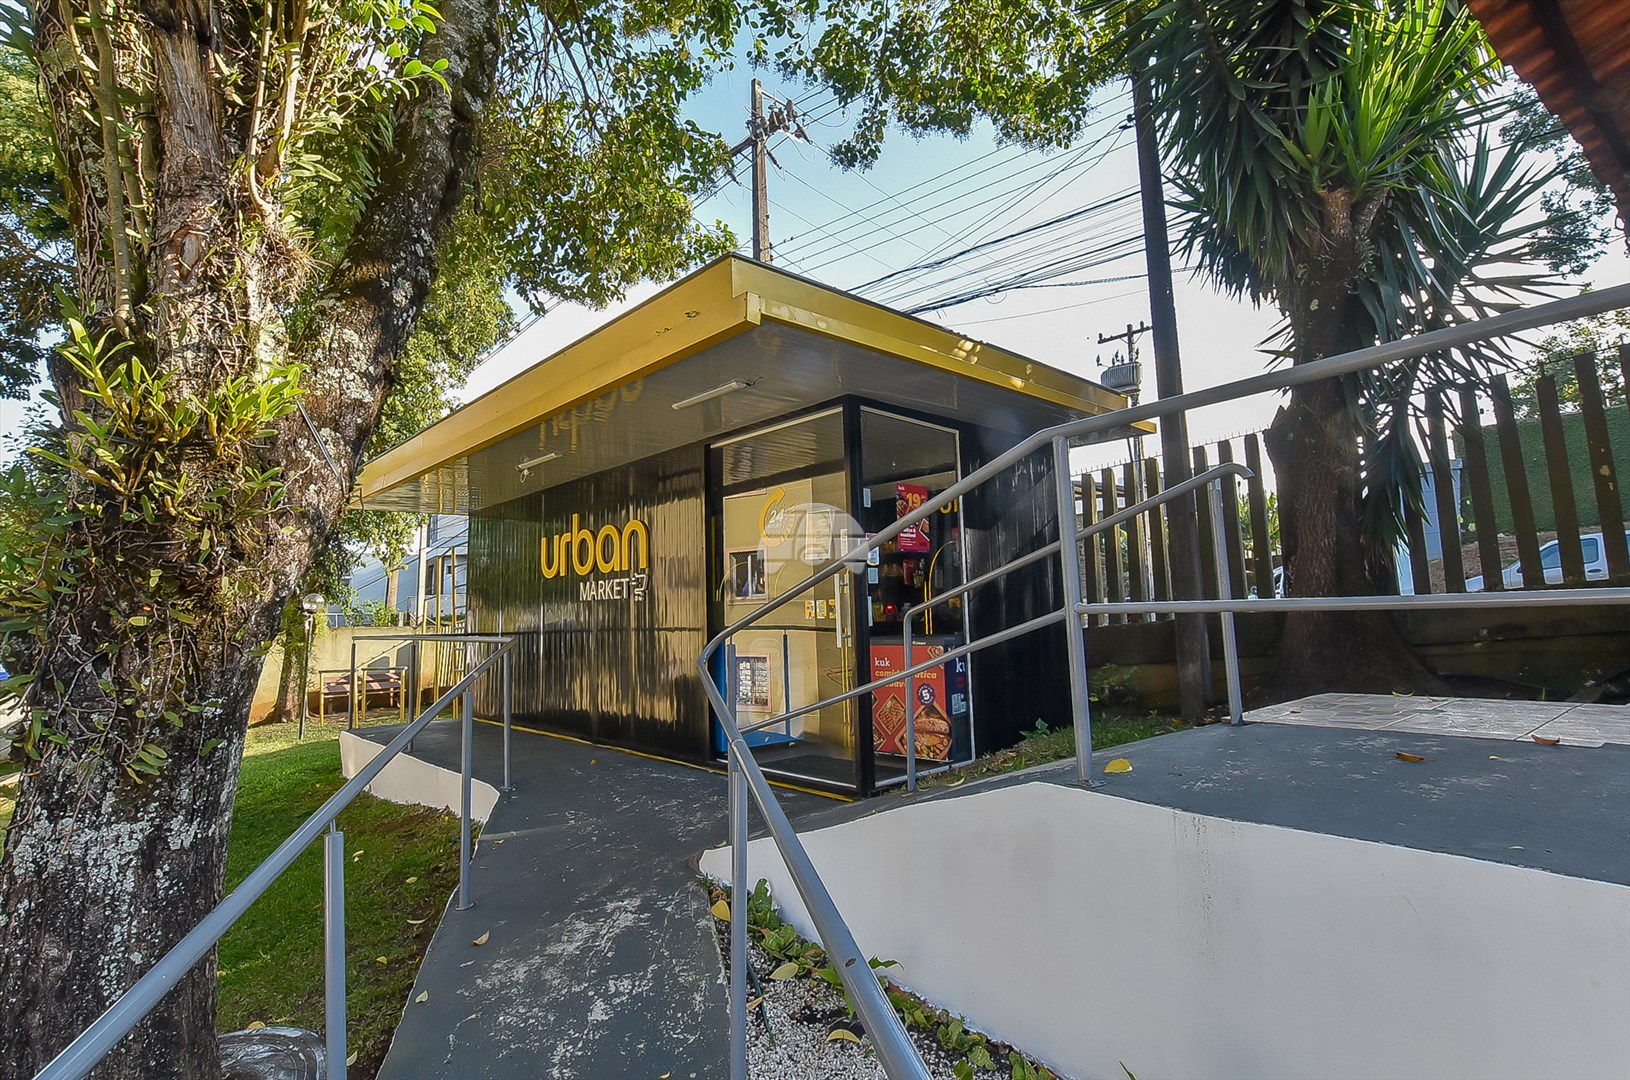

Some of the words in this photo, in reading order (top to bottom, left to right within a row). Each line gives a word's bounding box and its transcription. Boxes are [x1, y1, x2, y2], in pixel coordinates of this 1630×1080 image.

[906, 493, 921, 508] 19
[541, 513, 649, 579] urban
[580, 578, 630, 601] MARKET
[874, 657, 891, 667] kuk
[921, 689, 931, 701] 5
